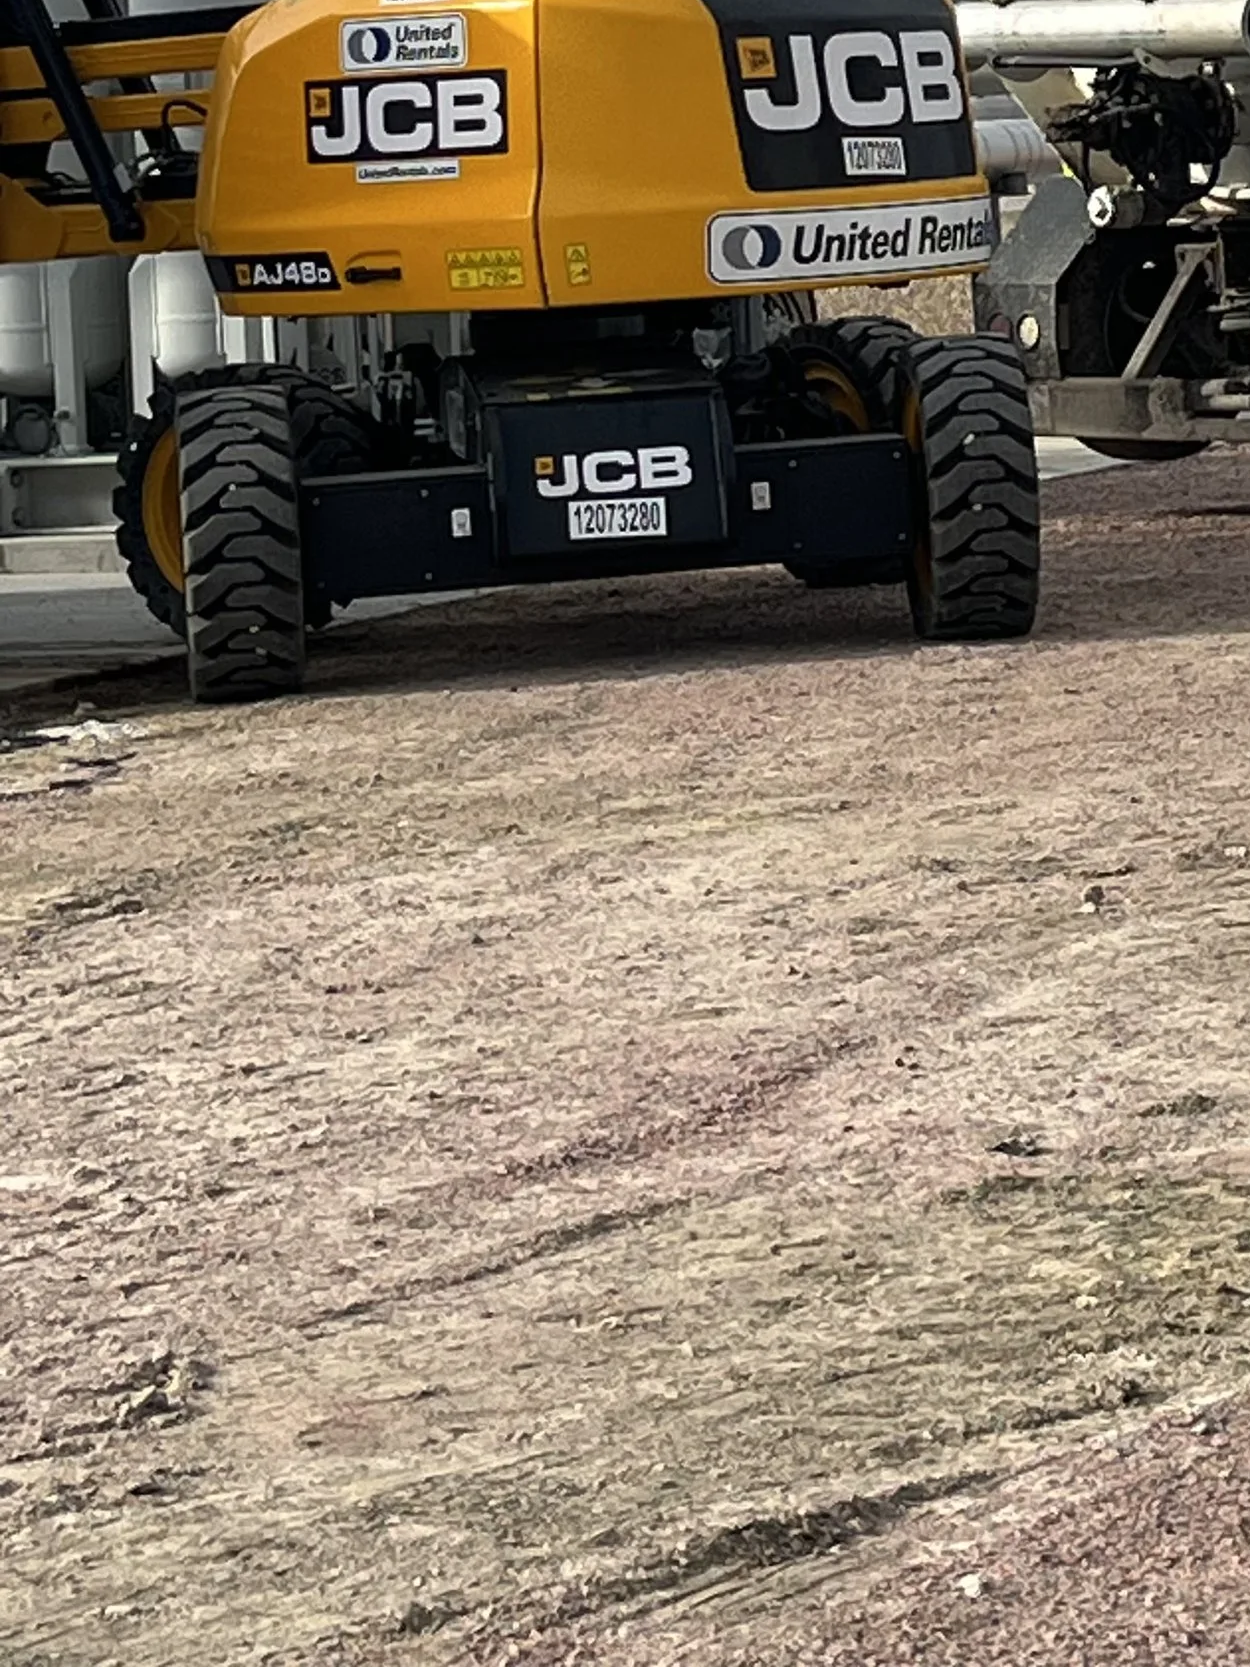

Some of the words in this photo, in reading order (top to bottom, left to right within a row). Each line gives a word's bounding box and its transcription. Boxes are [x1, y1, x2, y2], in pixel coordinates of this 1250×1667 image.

[395, 22, 455, 42] United
[395, 42, 459, 61] Rentals
[743, 30, 963, 131] JCB
[311, 76, 503, 156] JCB
[793, 218, 911, 265] United
[918, 210, 996, 255] Rental
[536, 445, 693, 498] JCB
[573, 502, 661, 535] 12073280
